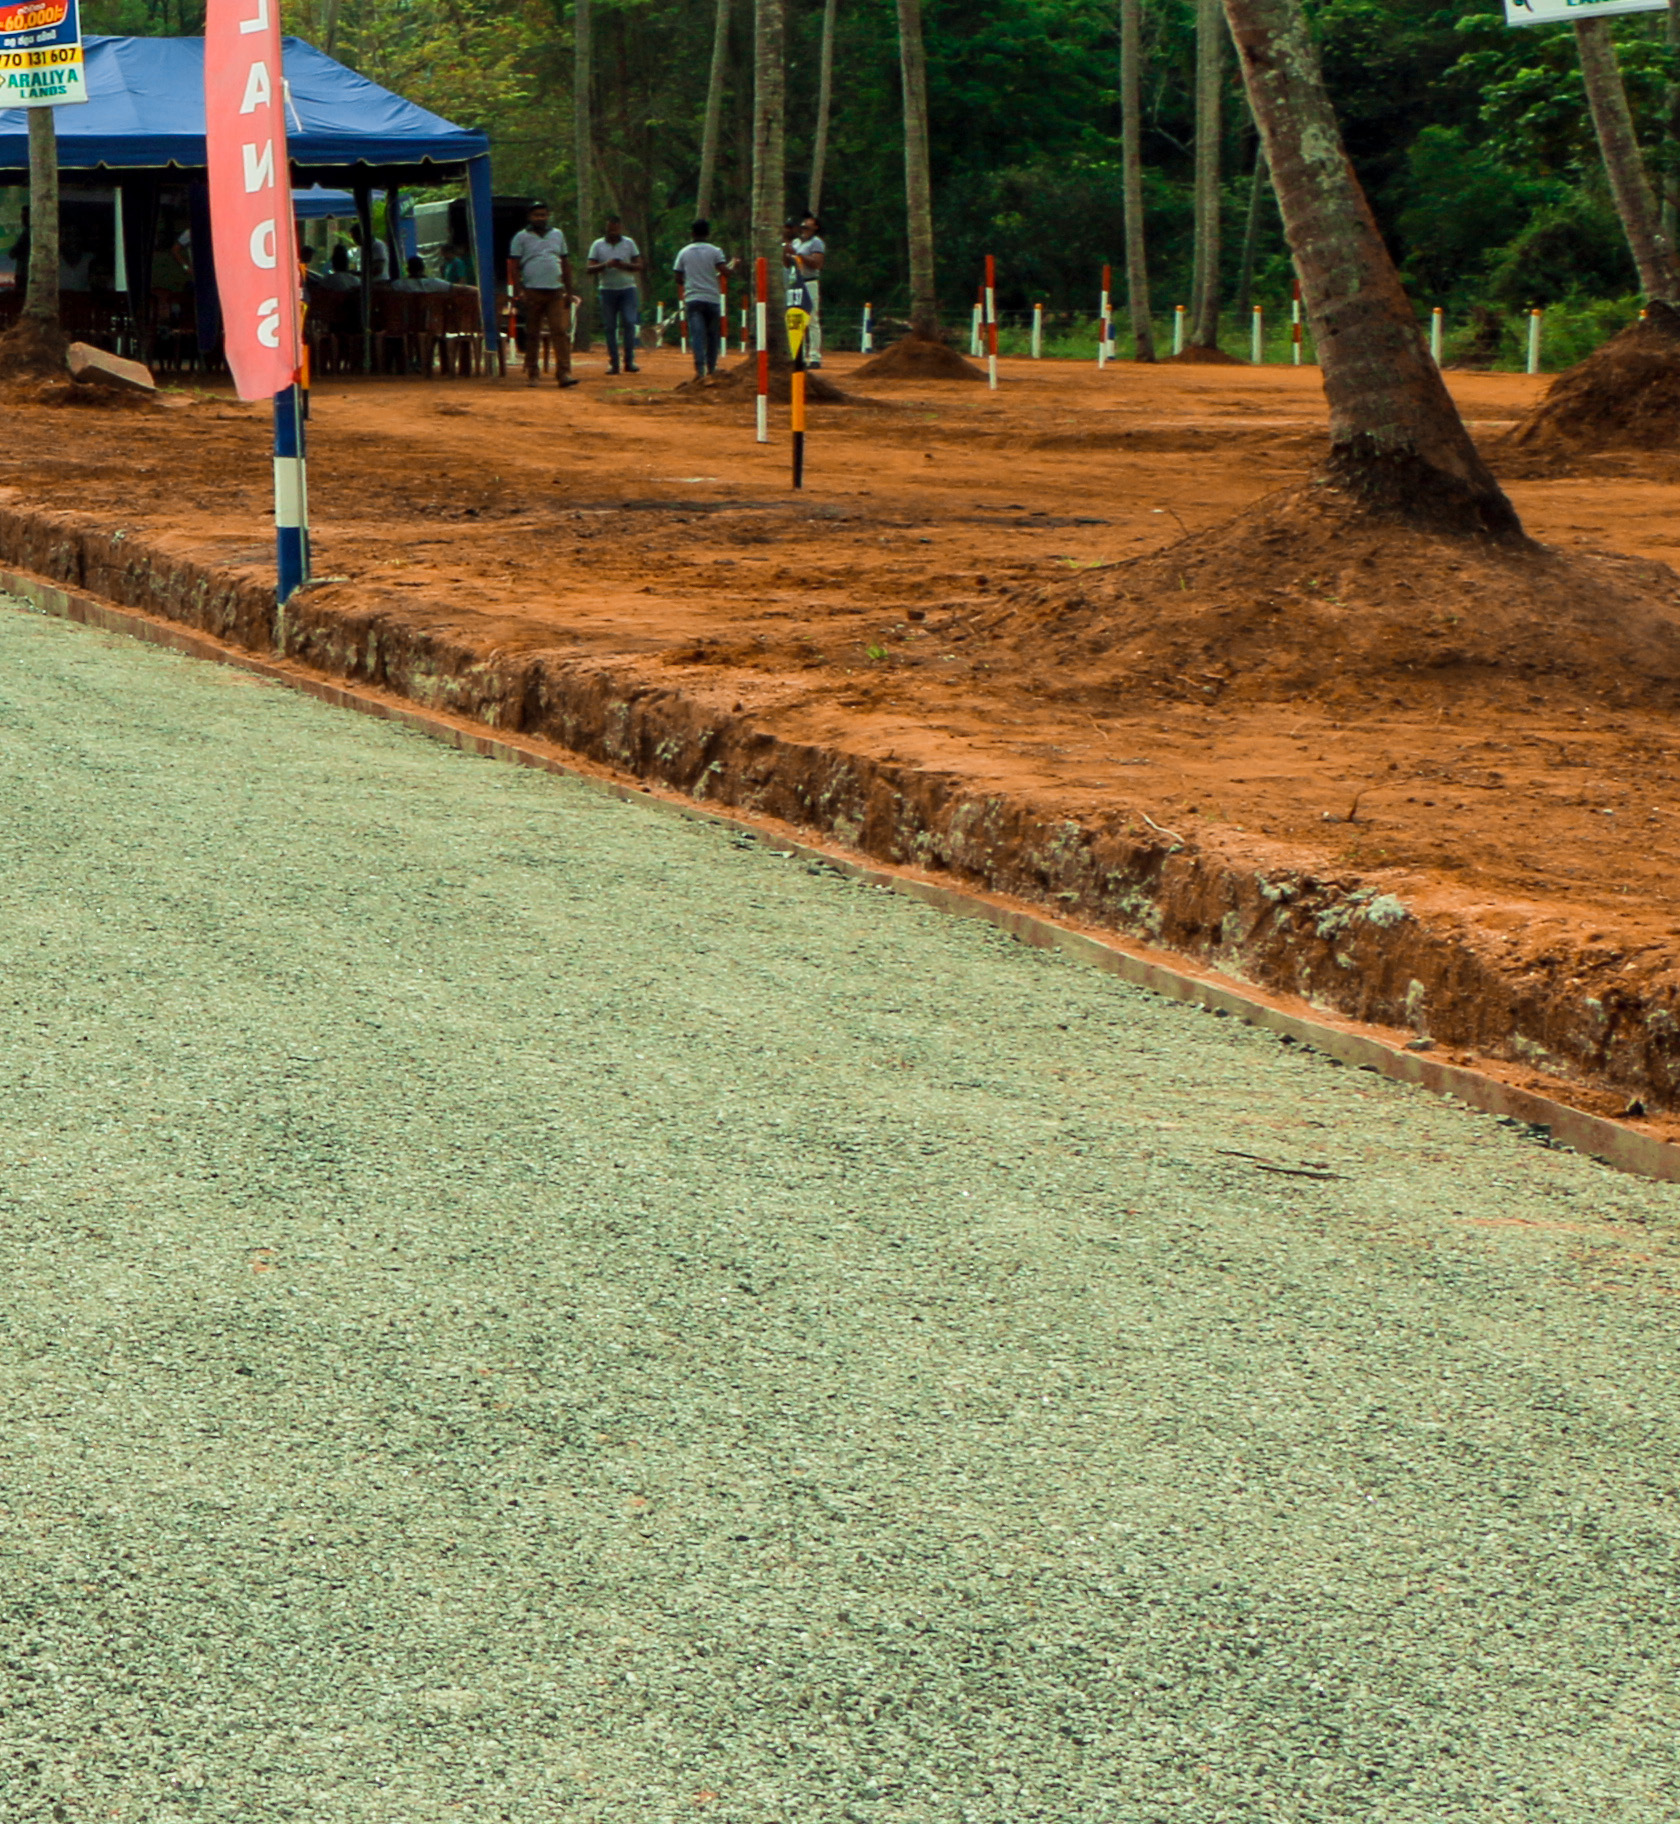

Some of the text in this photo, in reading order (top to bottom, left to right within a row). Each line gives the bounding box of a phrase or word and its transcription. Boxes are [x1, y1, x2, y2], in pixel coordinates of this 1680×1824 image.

[28, 51, 47, 66] 131
[51, 47, 77, 63] 607
[7, 68, 79, 88] ARALIYA
[20, 84, 68, 99] LANDS
